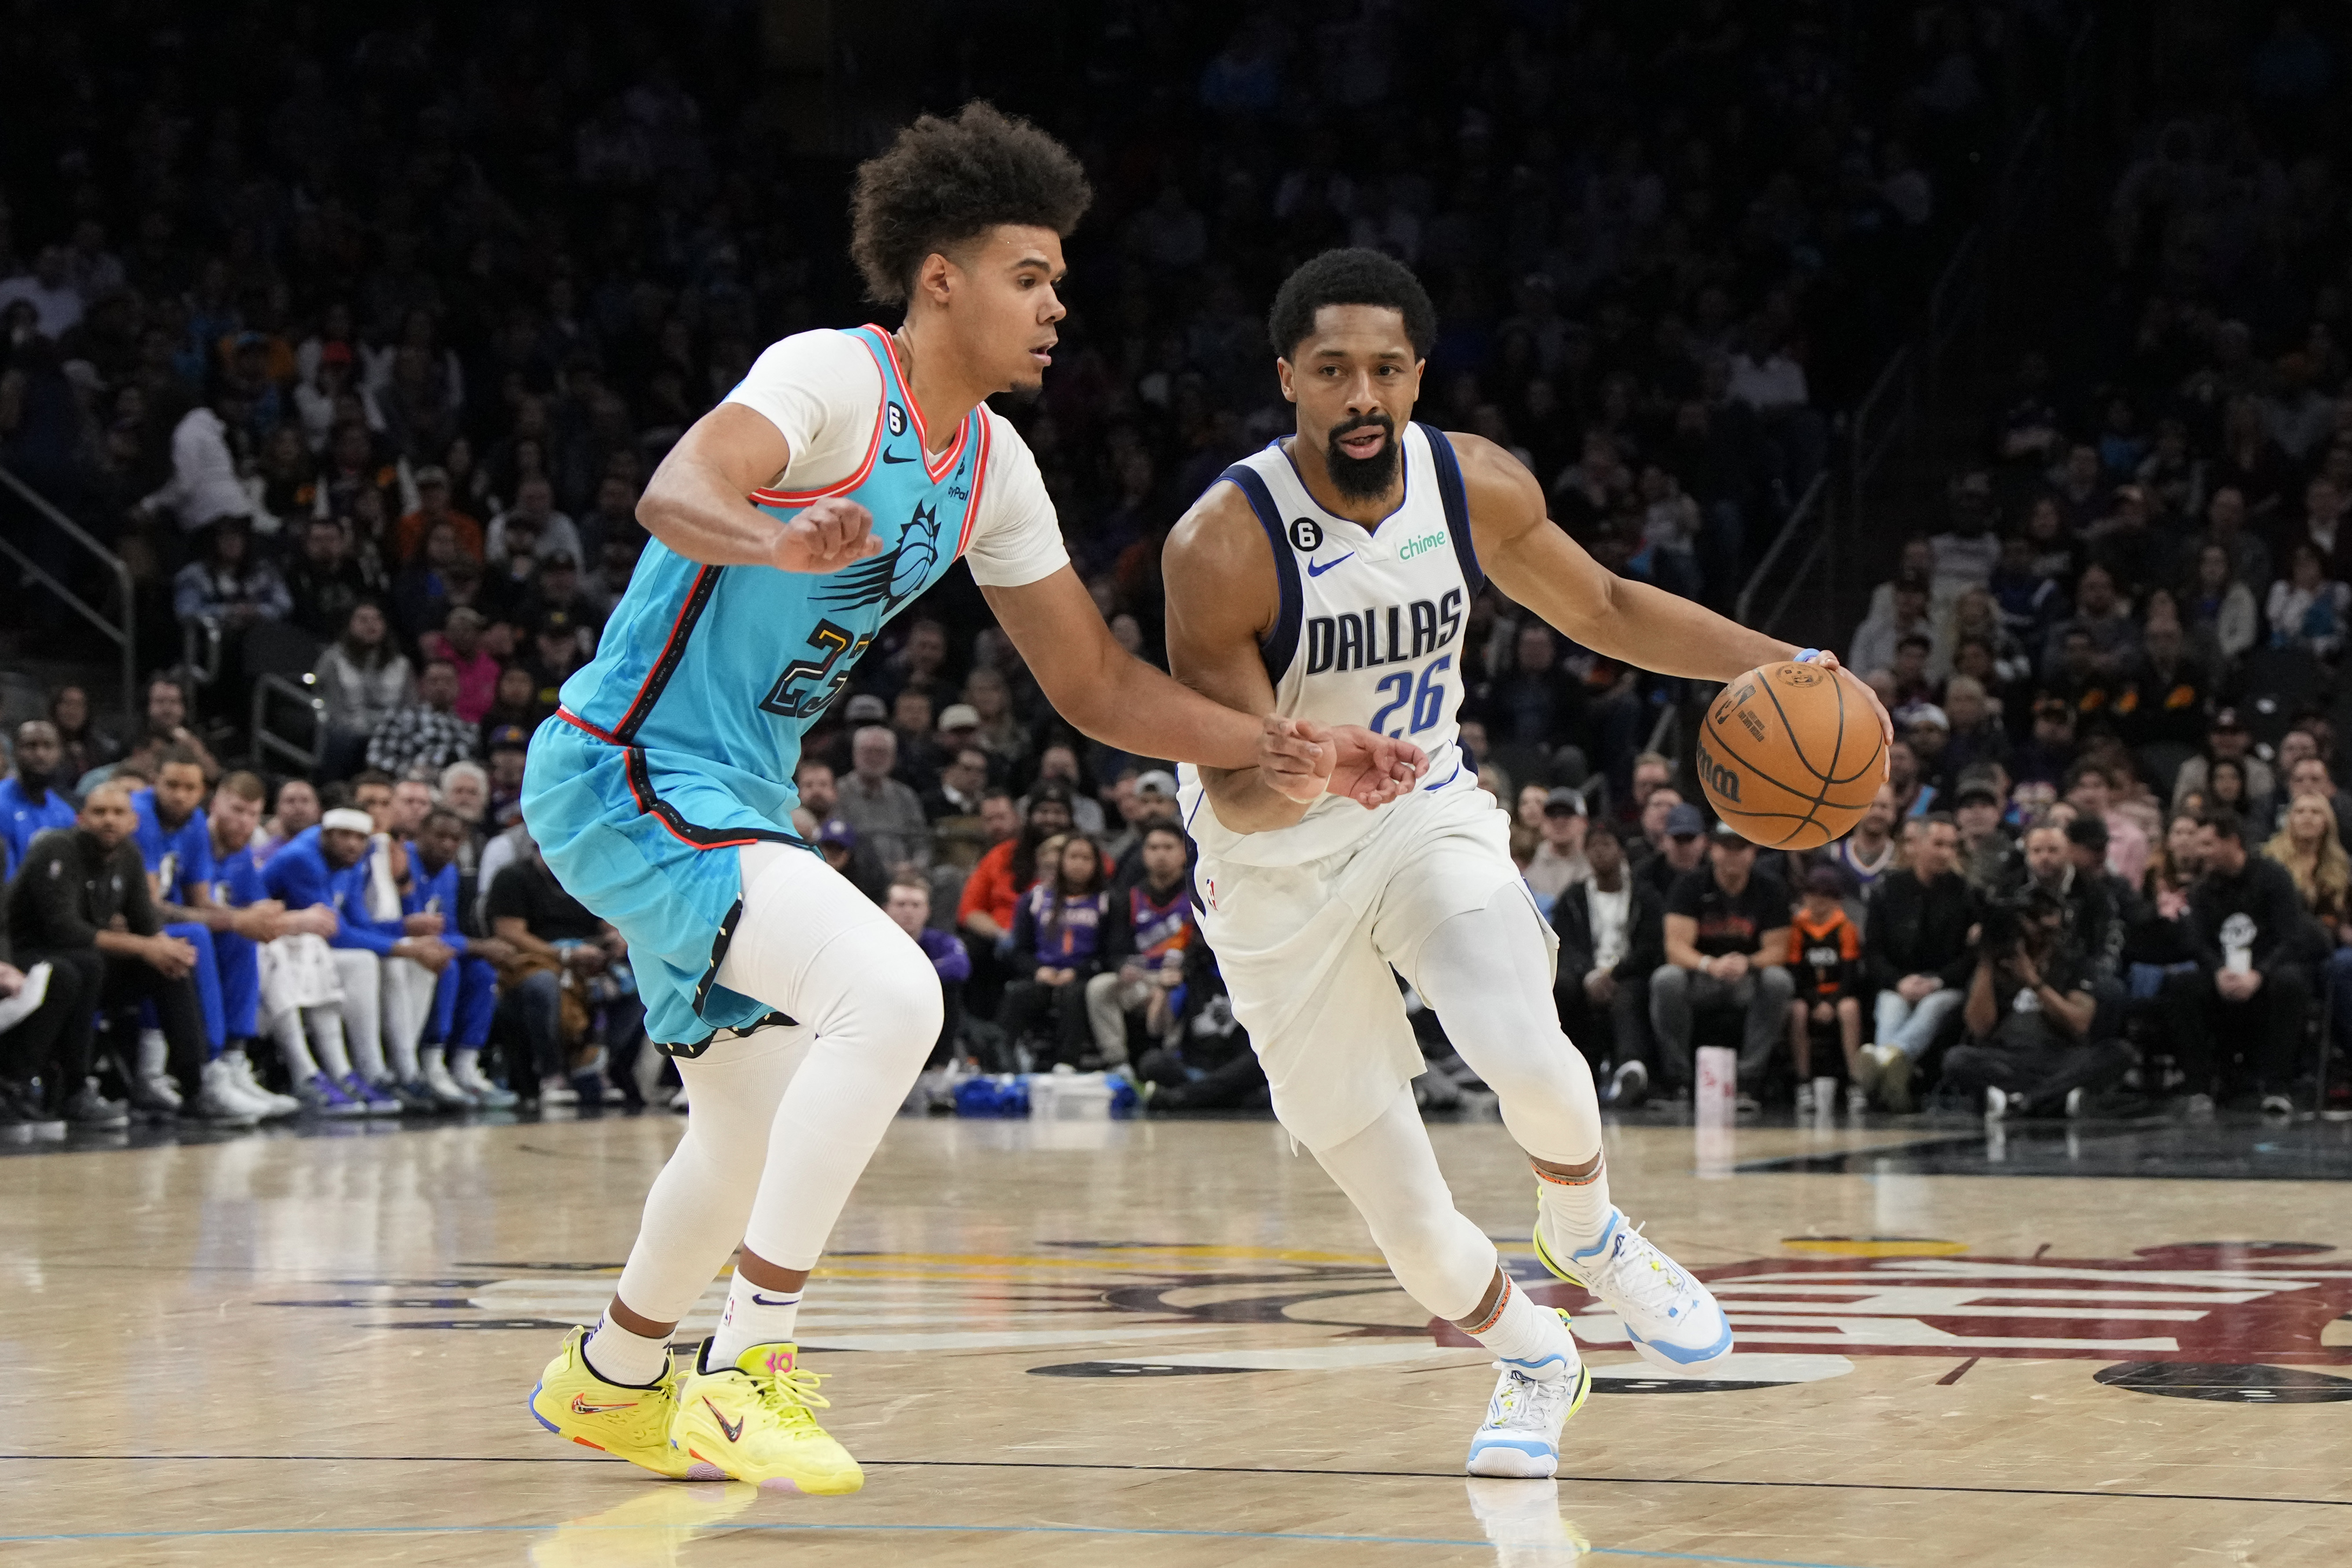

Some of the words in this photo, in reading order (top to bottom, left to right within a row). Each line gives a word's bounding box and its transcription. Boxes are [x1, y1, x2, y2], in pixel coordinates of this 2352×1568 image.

[889, 405, 901, 433] 6
[948, 486, 969, 501] ayPal
[1297, 522, 1316, 547] 6
[1400, 529, 1446, 560] chime
[1306, 586, 1462, 676] DALLAS
[1368, 652, 1452, 741] 26
